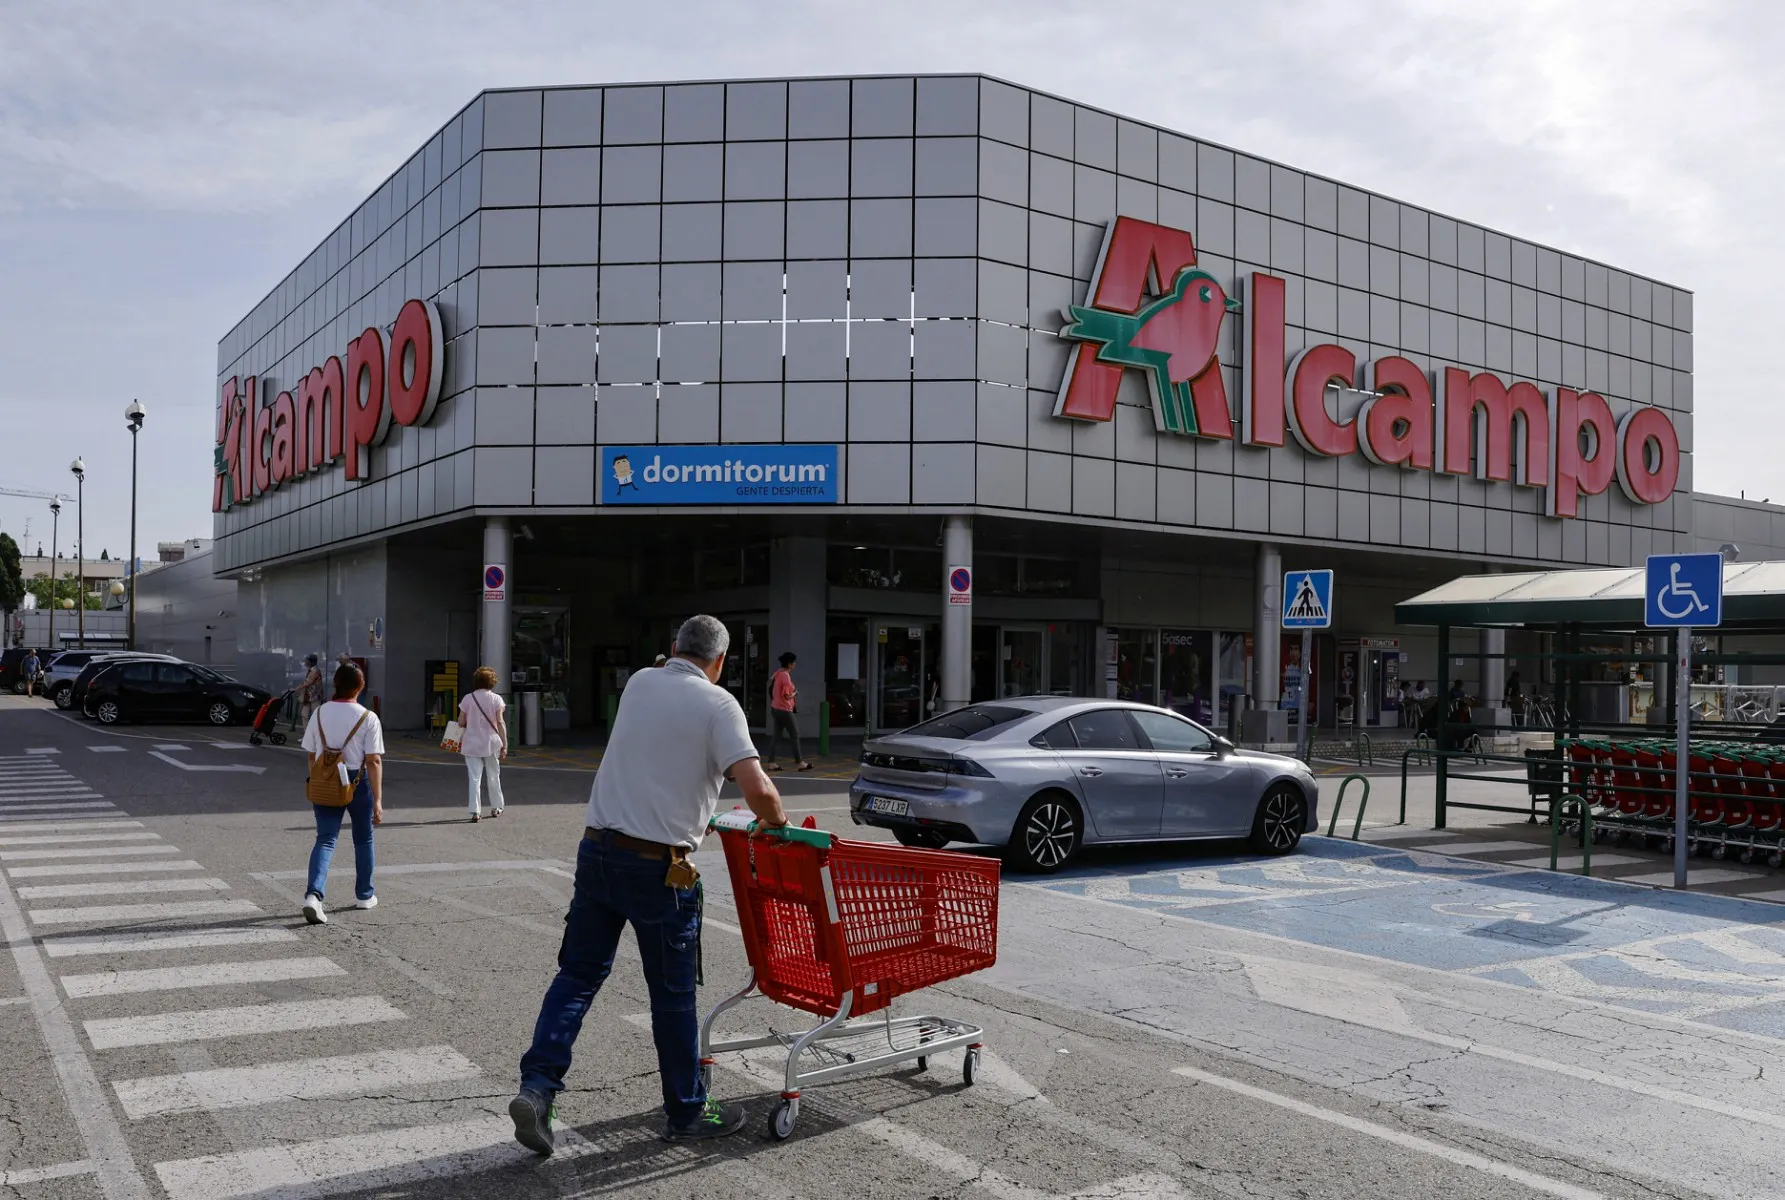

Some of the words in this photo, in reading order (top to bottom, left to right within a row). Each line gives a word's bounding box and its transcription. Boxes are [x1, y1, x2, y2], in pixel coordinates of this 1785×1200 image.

[1053, 214, 1680, 520] Alcampo
[212, 298, 443, 513] Alcampo
[643, 455, 827, 483] dormitorum
[736, 486, 769, 496] GENTE
[772, 486, 825, 496] DESPIERTA
[873, 798, 891, 811] 5237
[891, 800, 906, 814] LXR
